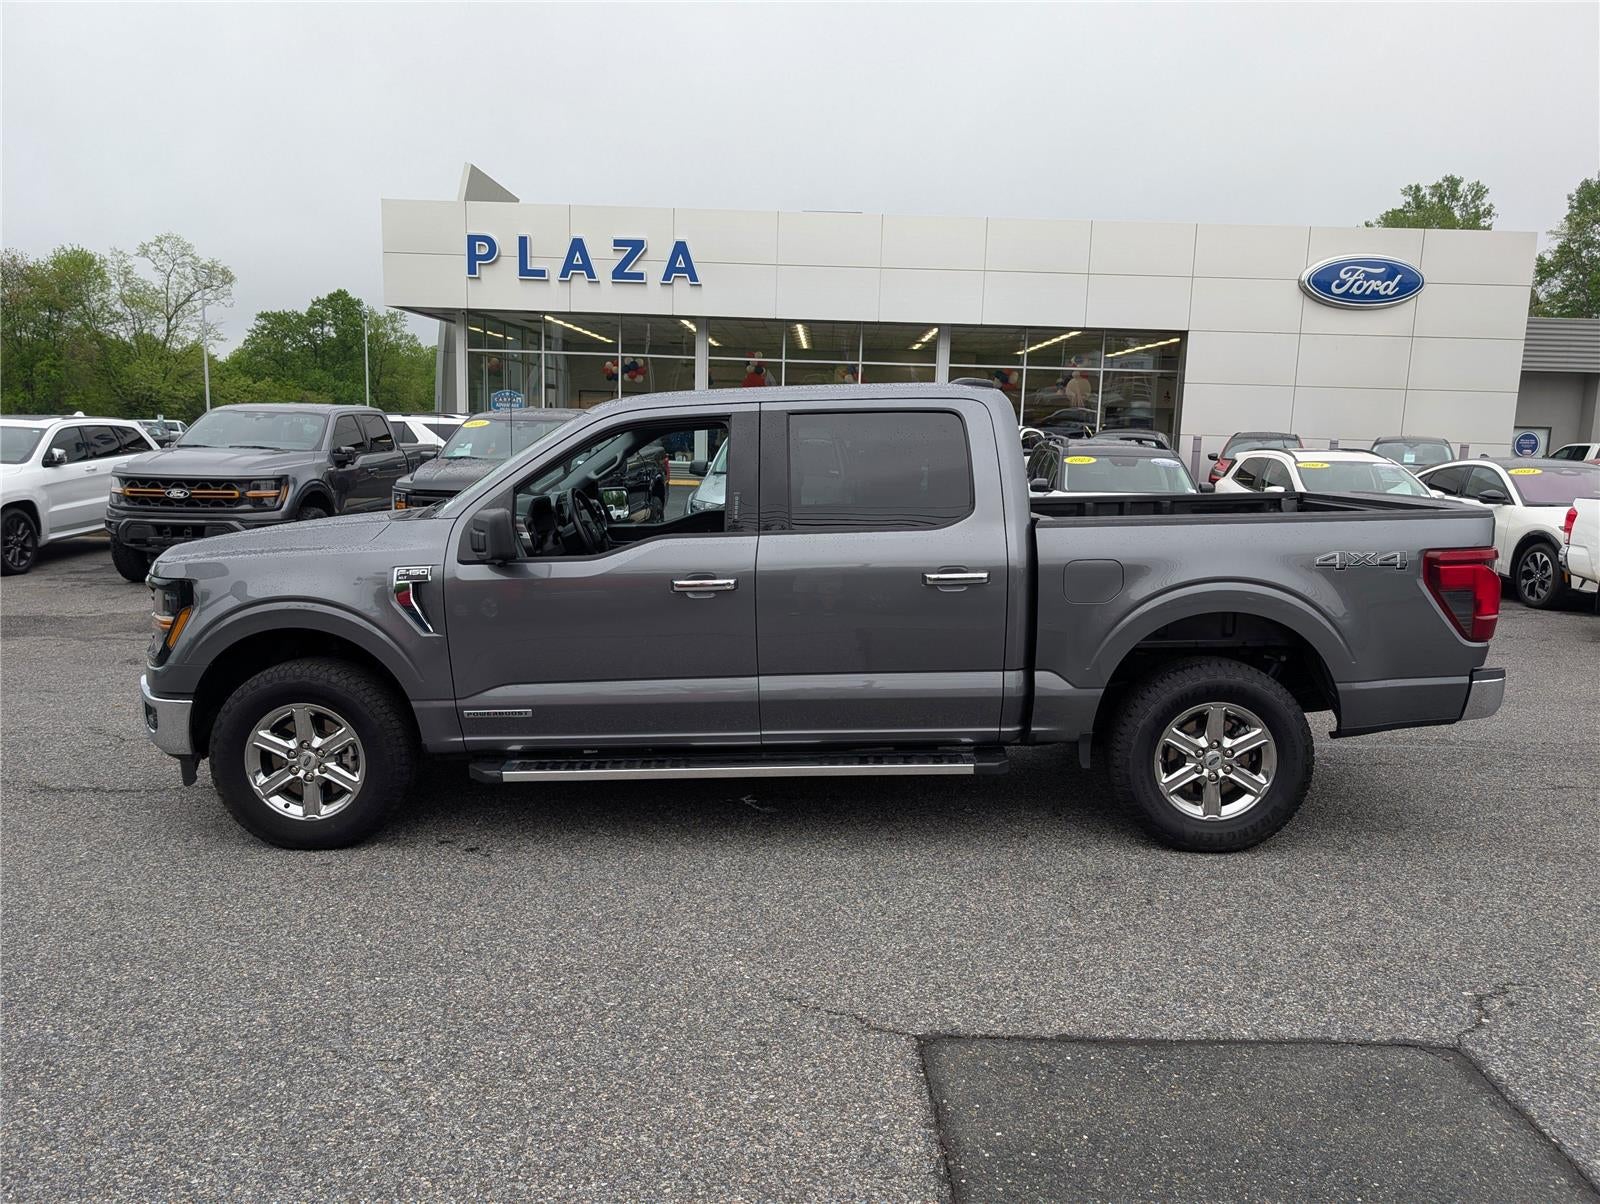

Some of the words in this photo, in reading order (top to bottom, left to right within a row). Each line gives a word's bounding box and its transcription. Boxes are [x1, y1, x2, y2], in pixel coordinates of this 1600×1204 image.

[465, 232, 701, 286] PLAZA
[1331, 265, 1402, 296] Ford
[397, 568, 428, 576] F-150
